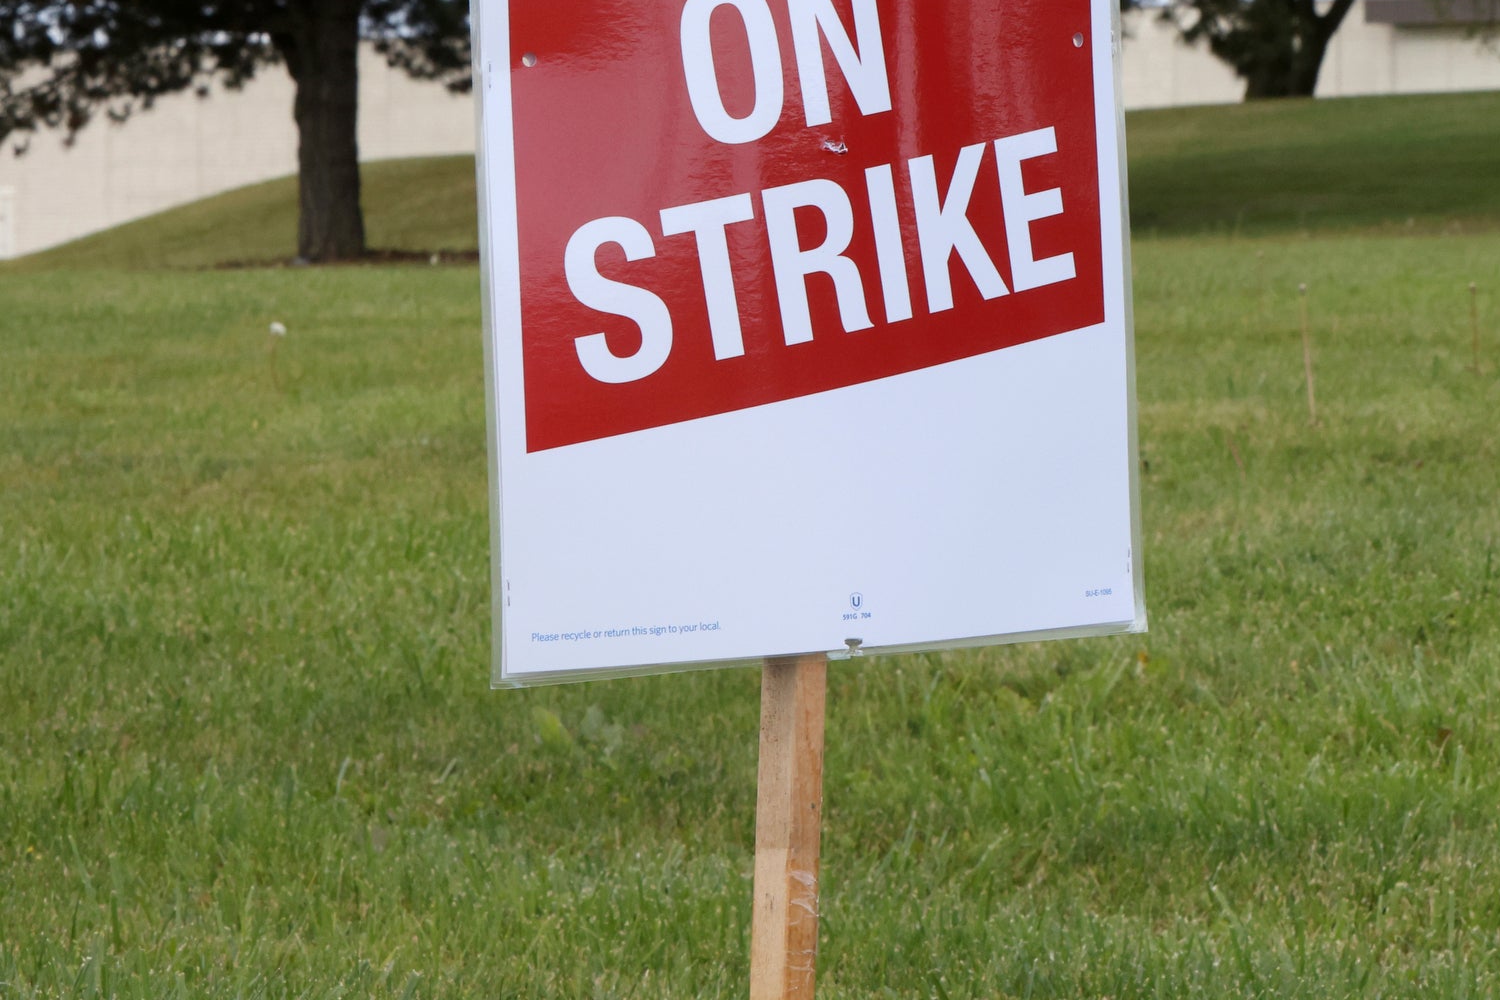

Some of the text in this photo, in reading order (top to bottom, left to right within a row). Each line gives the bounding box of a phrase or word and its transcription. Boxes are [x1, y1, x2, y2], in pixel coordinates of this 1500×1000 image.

[563, 126, 1077, 384] STRIKE
[531, 621, 722, 642] Please recycle or return this sign to your local.
